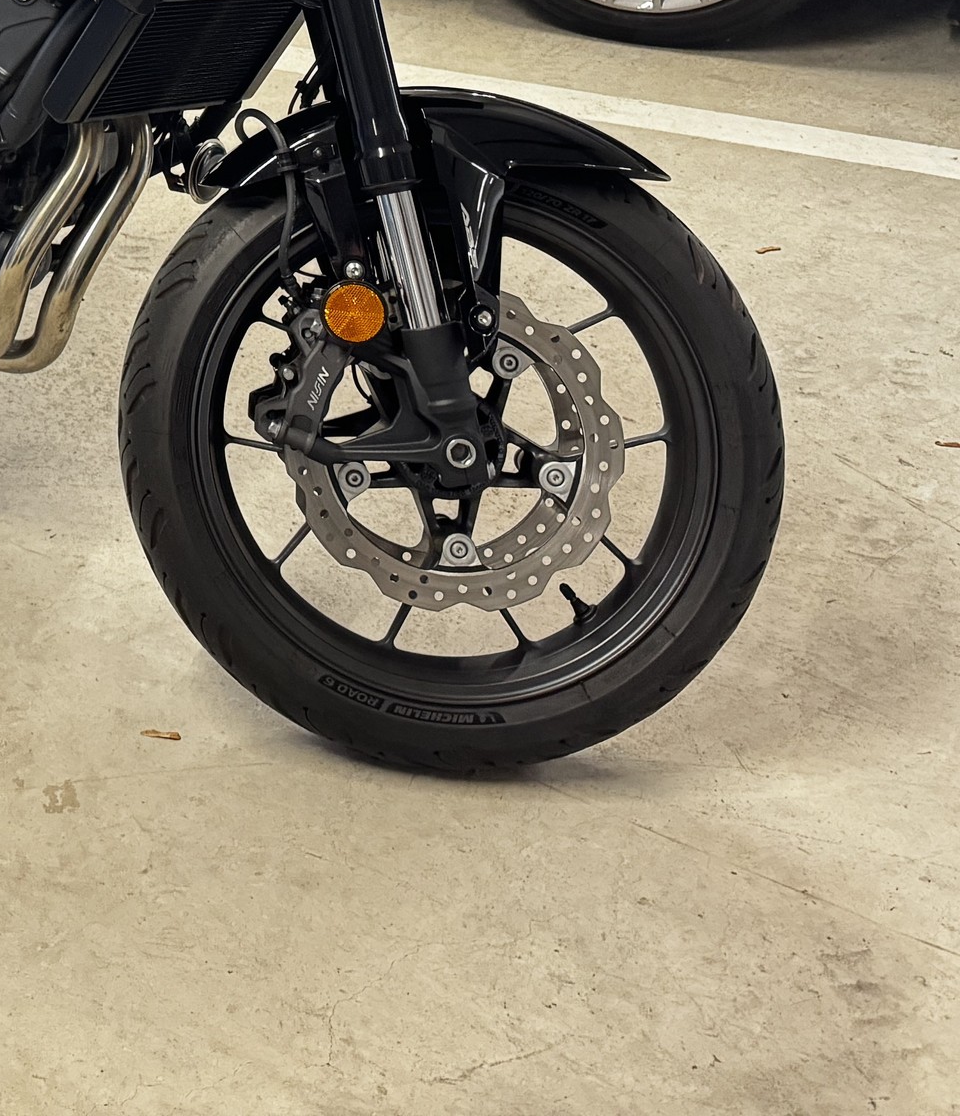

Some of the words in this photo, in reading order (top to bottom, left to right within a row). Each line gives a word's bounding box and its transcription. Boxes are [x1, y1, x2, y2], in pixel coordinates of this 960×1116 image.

[322, 677, 334, 685] 6
[336, 685, 380, 707] ROAD
[393, 705, 474, 724] MICHELIN
